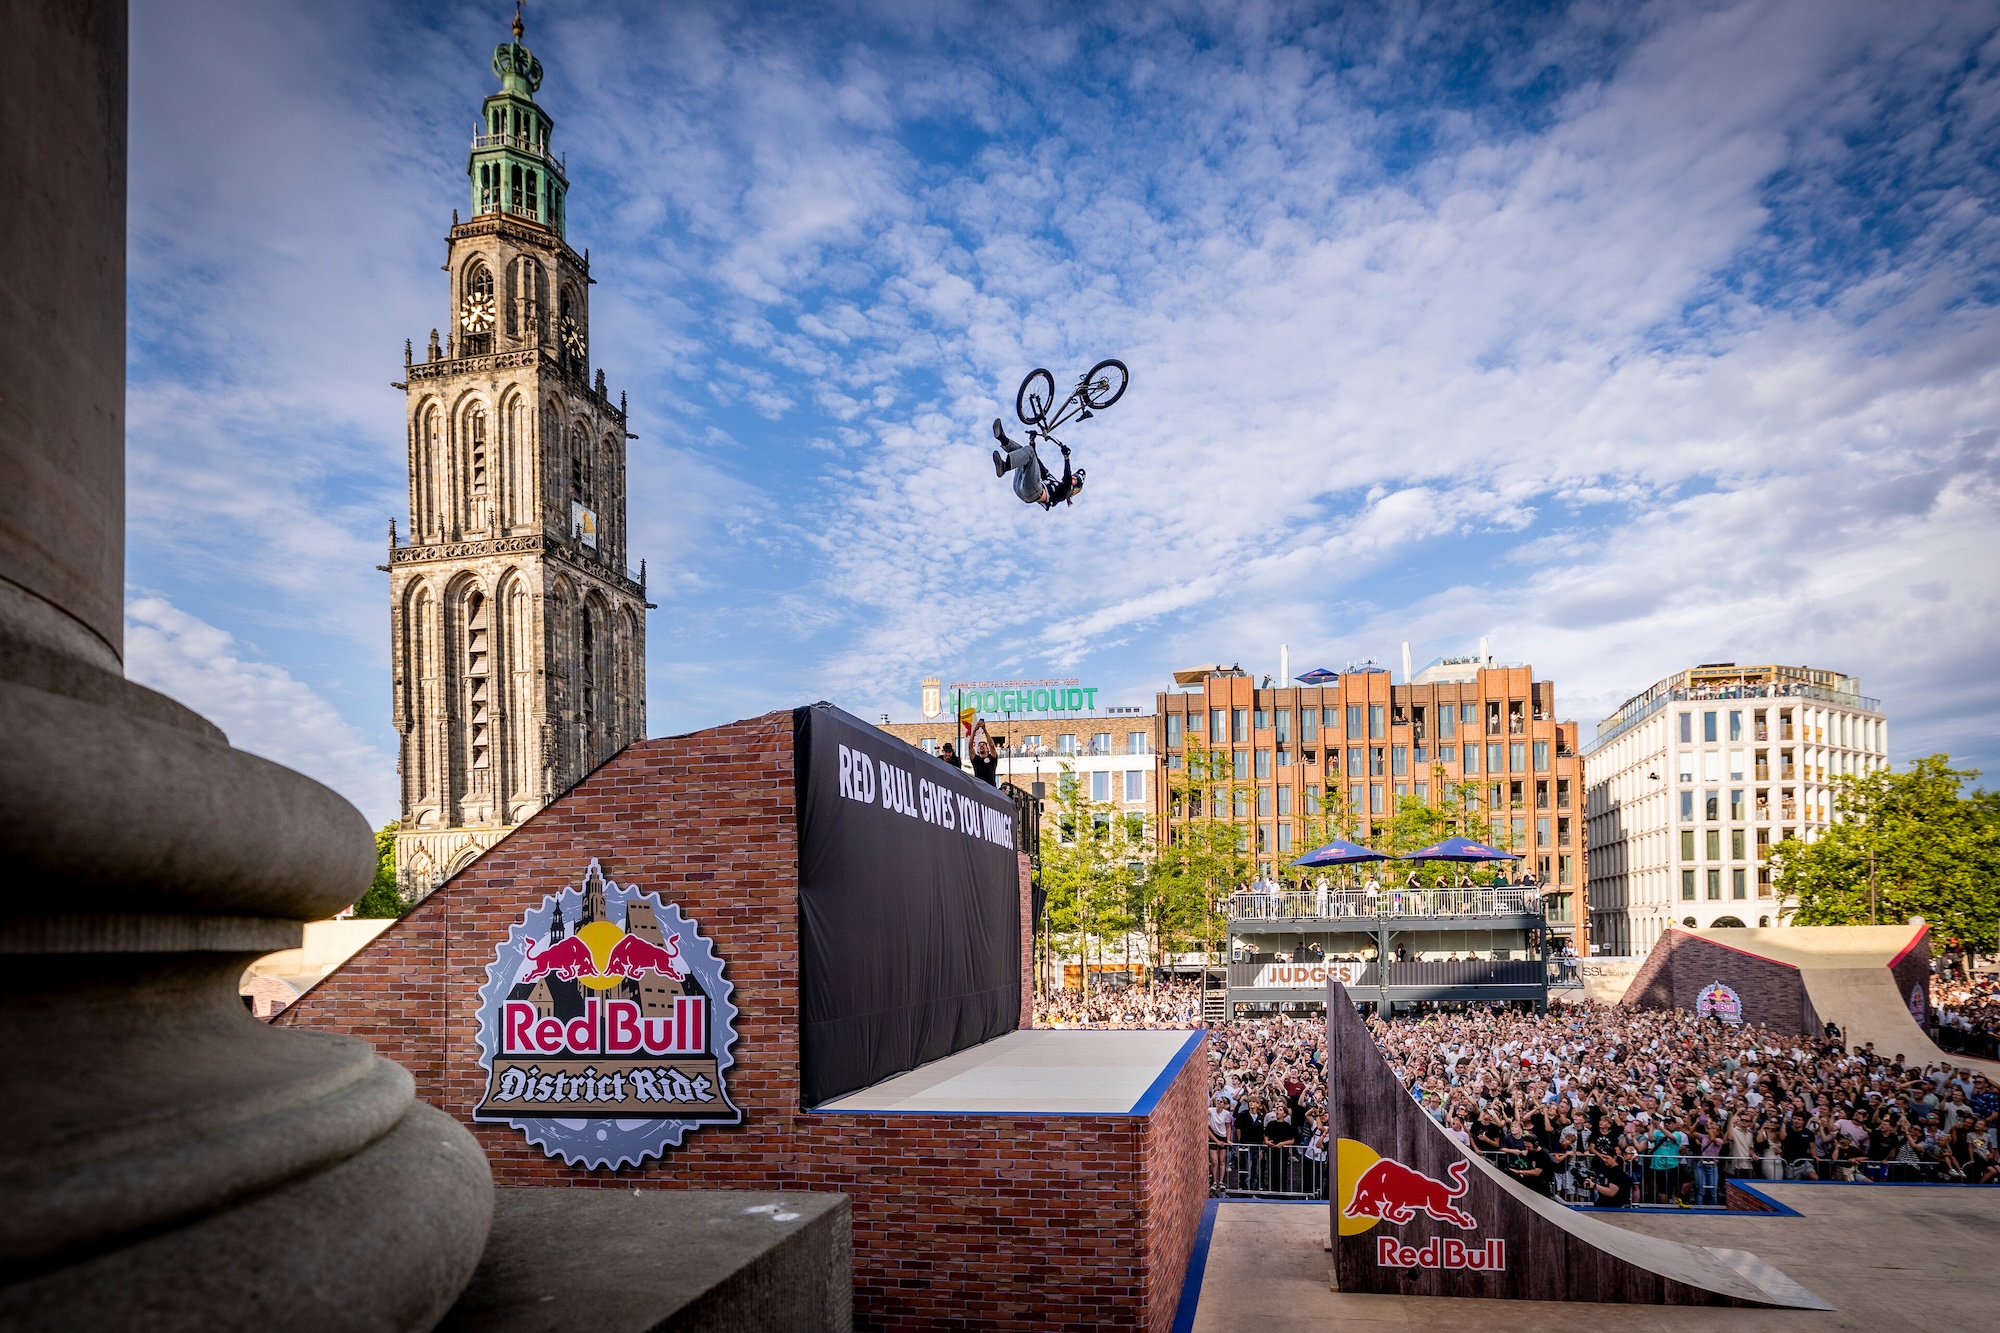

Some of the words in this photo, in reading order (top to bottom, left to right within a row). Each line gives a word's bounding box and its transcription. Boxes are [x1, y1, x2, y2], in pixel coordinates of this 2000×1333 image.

[949, 687, 1098, 714] HOOGHOUDT
[838, 744, 876, 804] RED
[879, 760, 918, 819] BULL
[919, 777, 956, 831] GIVES
[956, 792, 981, 839] YOU
[505, 999, 598, 1052] Red
[608, 999, 702, 1052] Bull
[492, 1065, 627, 1102] District
[629, 1066, 716, 1103] Ride
[1378, 1237, 1440, 1268] Red
[1444, 1239, 1505, 1271] Bull
